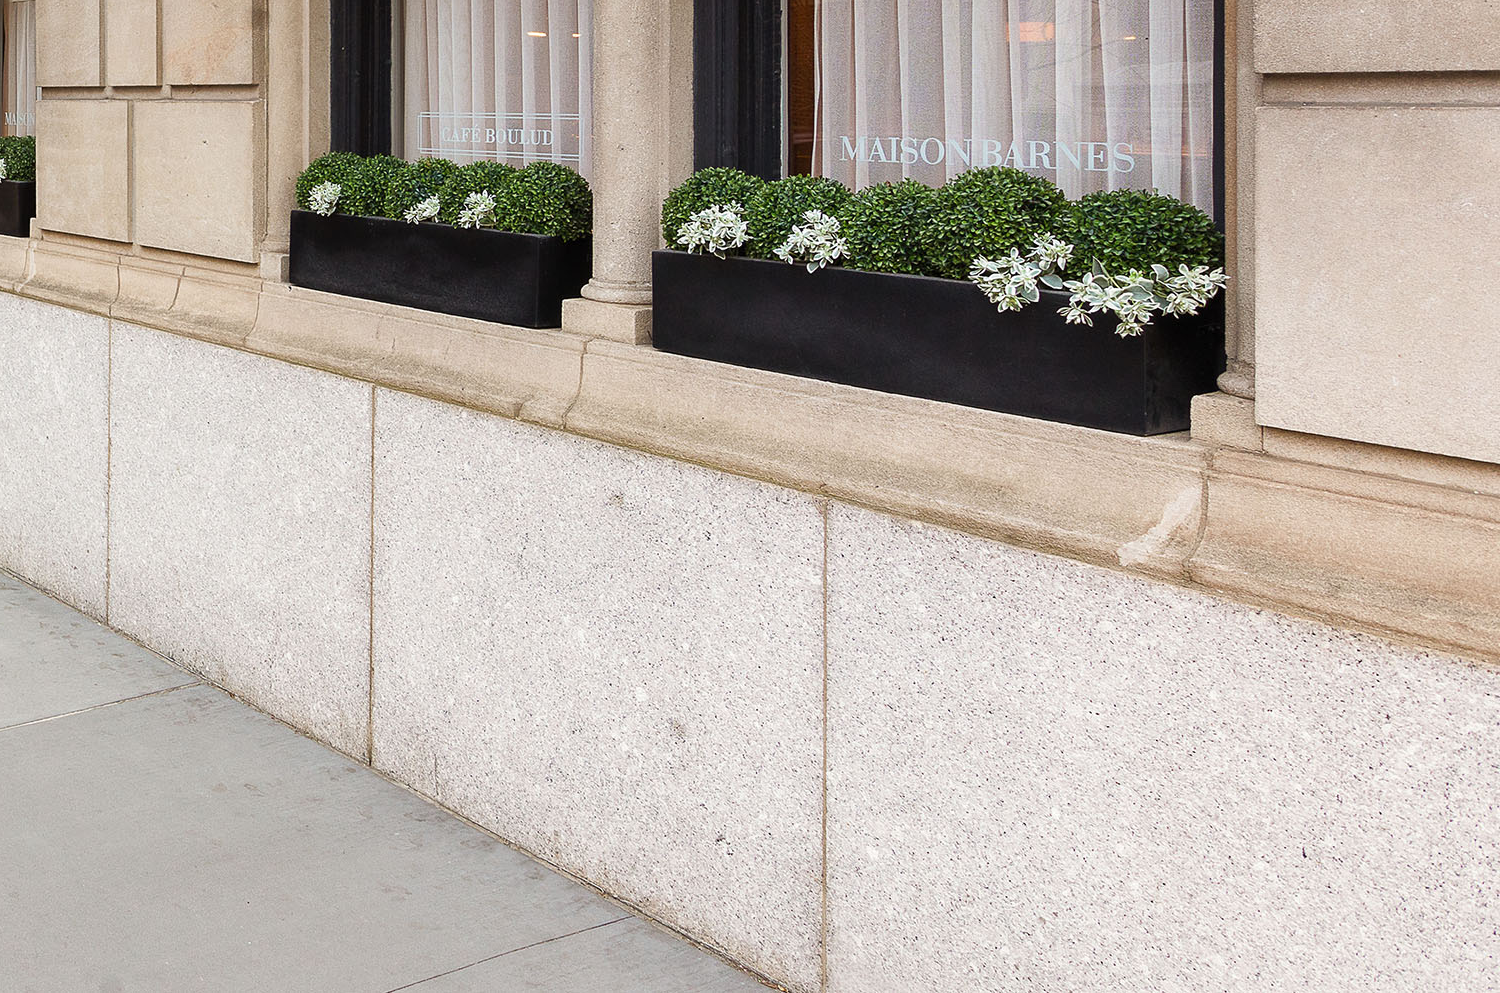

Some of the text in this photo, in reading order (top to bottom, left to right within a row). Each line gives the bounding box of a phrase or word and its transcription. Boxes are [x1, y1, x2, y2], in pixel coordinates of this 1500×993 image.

[441, 124, 554, 146] CAFÉ BOULUD
[840, 135, 1136, 173] MAISON BARNES
